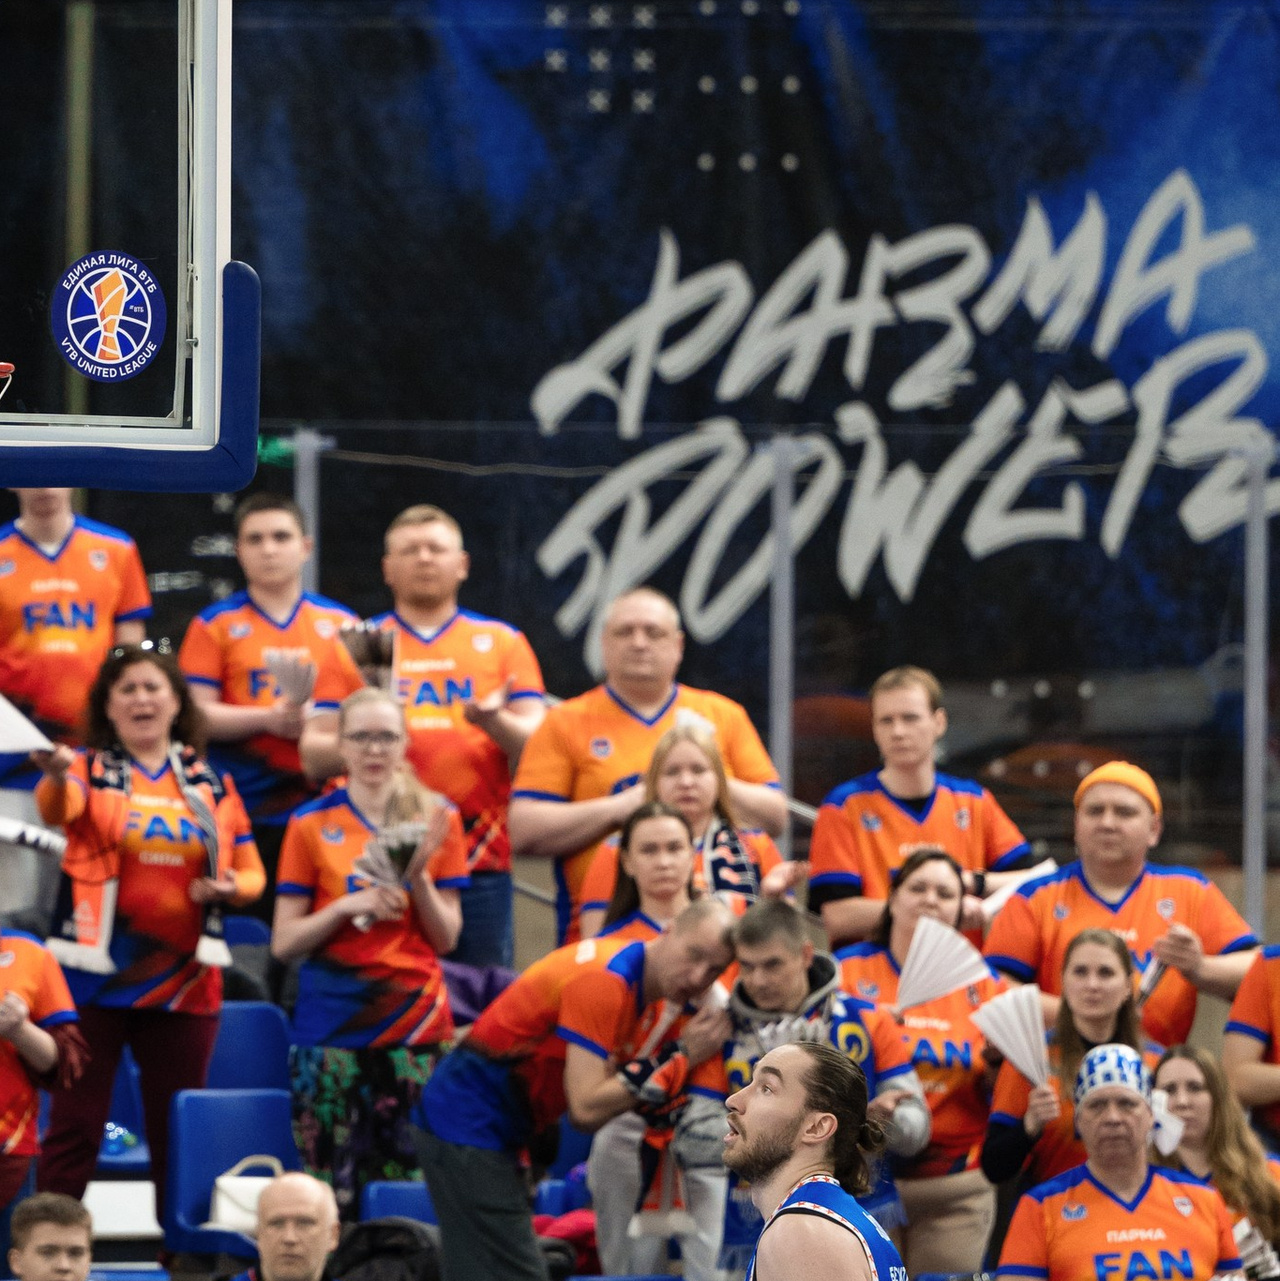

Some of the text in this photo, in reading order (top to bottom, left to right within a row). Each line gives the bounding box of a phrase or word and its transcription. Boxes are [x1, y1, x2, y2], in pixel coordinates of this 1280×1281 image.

[62, 254, 157, 294] ЕДИНАЯ ЛИГА ВТБ
[530, 167, 1256, 441] PARMA
[61, 336, 157, 378] VTB UNITED LEAGUE
[535, 326, 1280, 678] POWER
[22, 601, 96, 635] FAN
[903, 1035, 972, 1069] AN
[1105, 1227, 1167, 1243] ПАРМА
